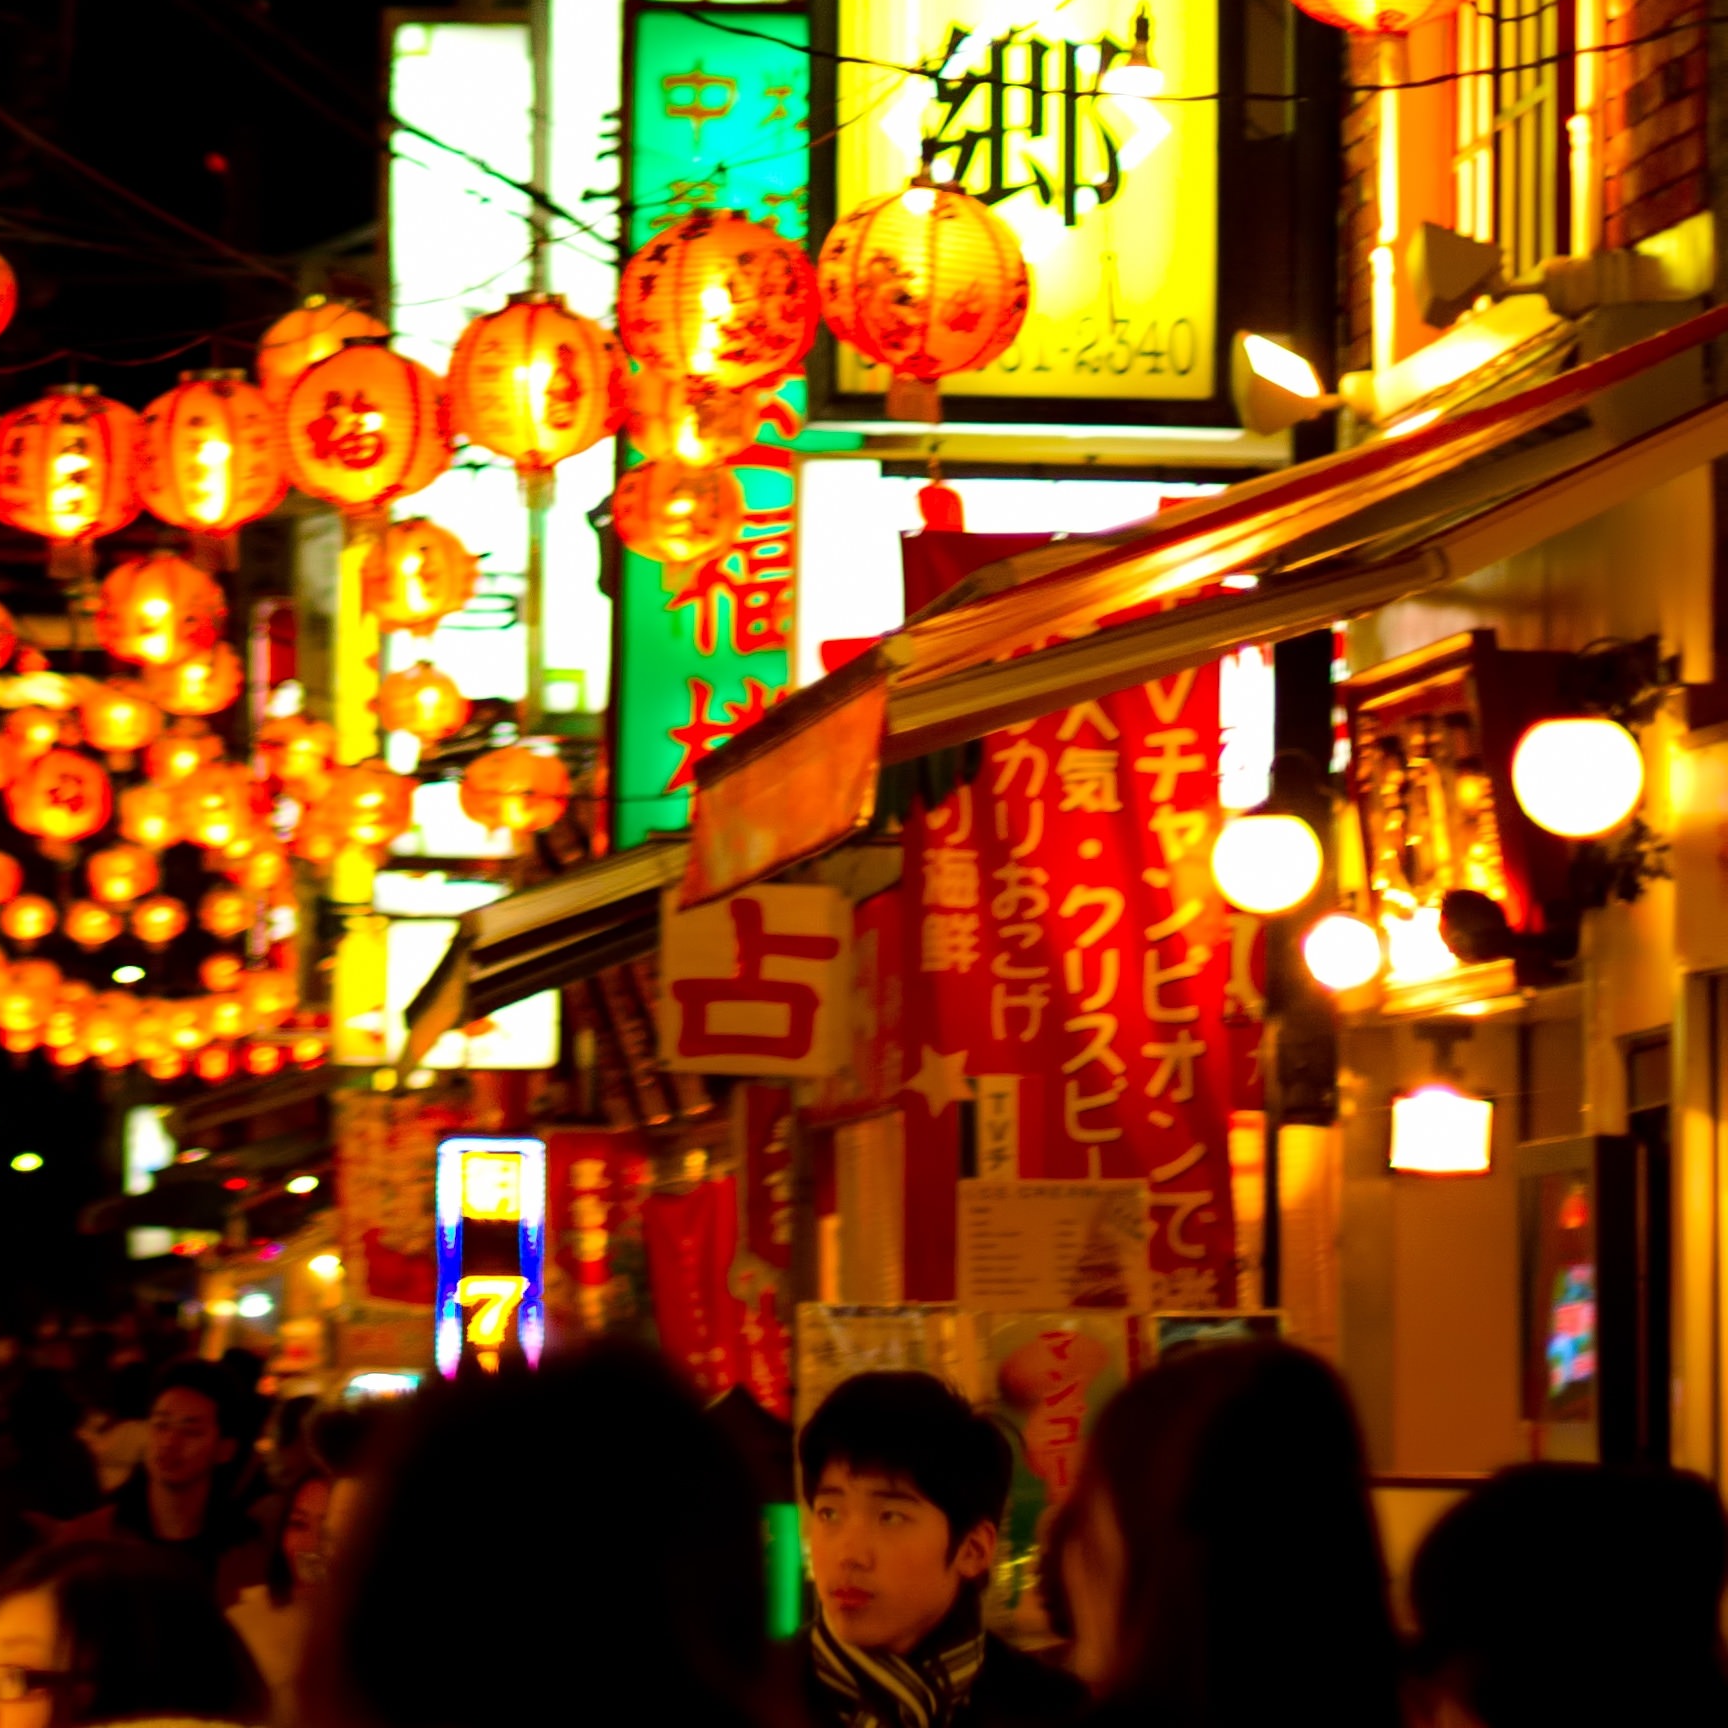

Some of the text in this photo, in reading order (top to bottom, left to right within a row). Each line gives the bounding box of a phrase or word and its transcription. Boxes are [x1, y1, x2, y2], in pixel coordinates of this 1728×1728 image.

[674, 896, 840, 1061] 占
[988, 720, 1051, 1043] カリおこげ
